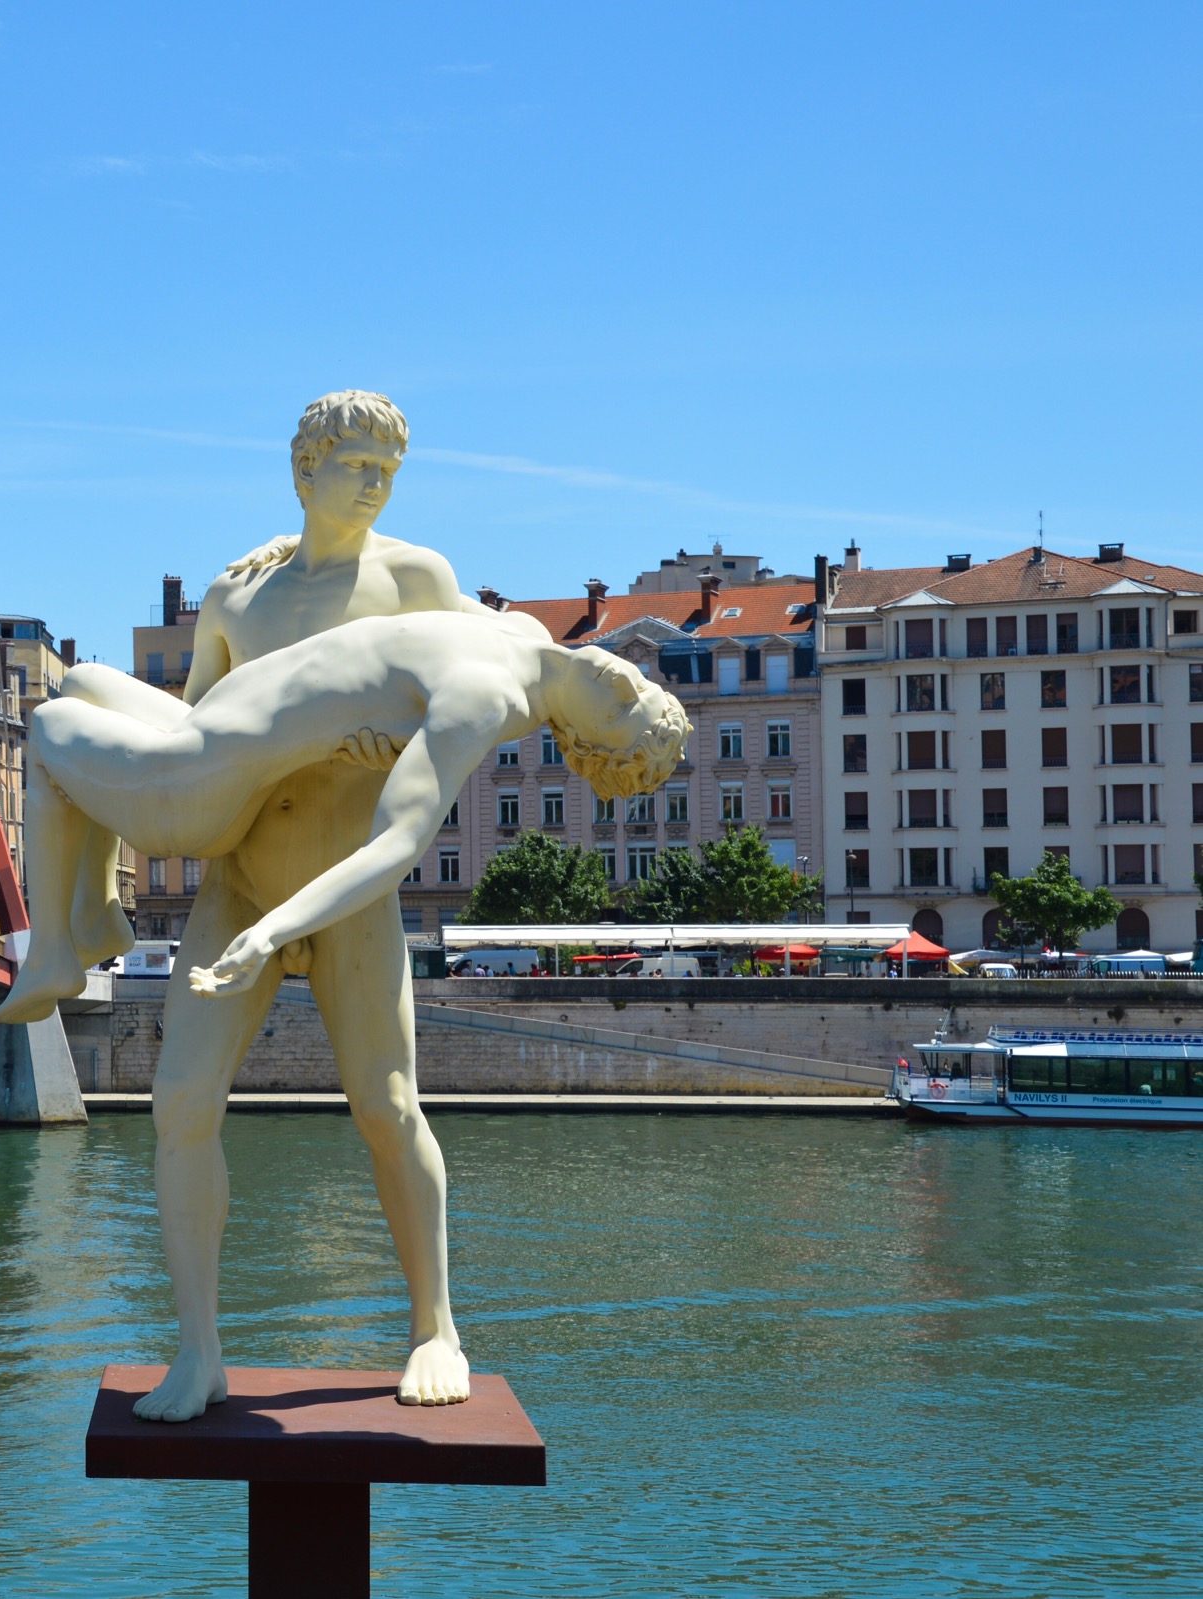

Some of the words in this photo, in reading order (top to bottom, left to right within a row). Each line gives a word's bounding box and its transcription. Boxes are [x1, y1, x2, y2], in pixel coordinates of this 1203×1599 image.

[1014, 1093, 1058, 1103] NAVILYS
[1061, 1094, 1068, 1103] II
[1092, 1096, 1128, 1105] Propulsion
[1129, 1097, 1162, 1105] électrique
